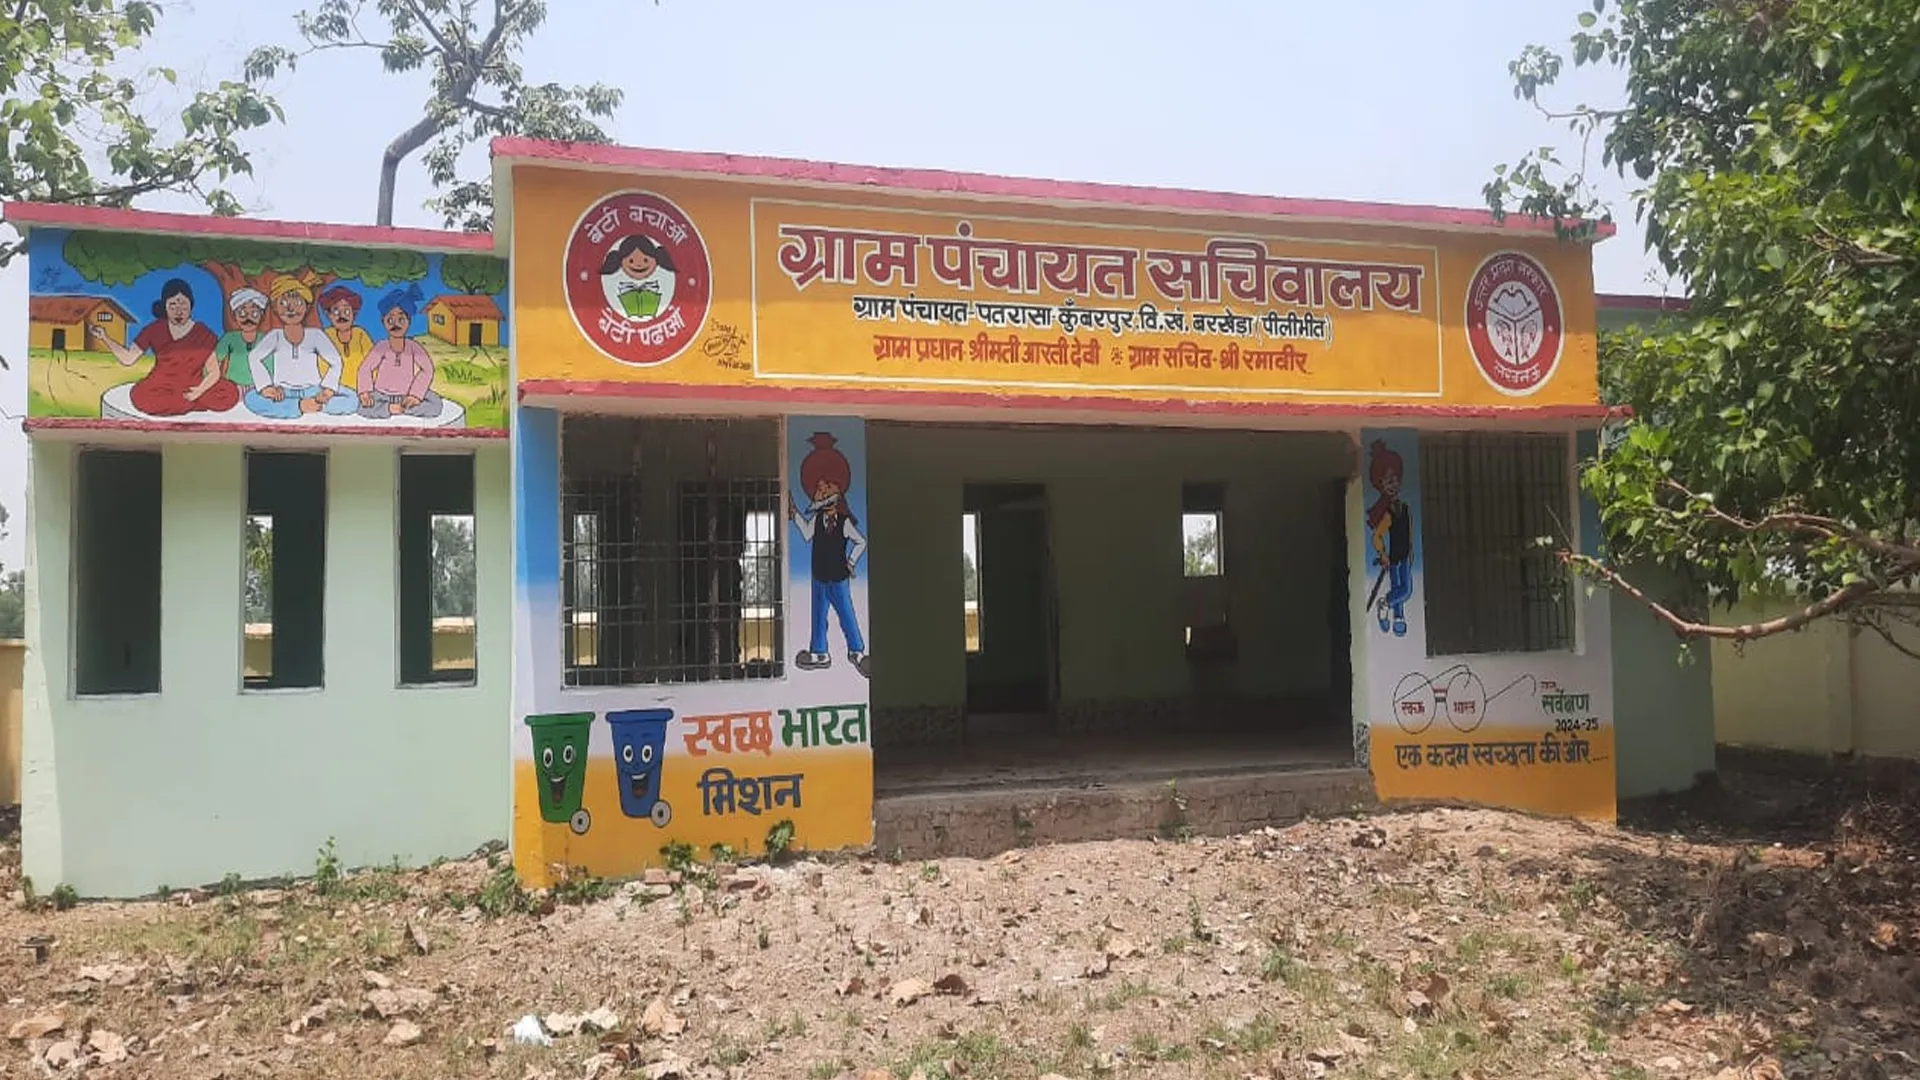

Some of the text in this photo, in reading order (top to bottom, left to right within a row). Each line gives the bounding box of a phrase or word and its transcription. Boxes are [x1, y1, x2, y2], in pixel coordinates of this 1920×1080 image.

[584, 204, 621, 244] बेटी
[779, 219, 1424, 312] ग्राम पंचायत सचिवालय
[599, 307, 635, 344] बेटी
[853, 296, 896, 319] ग्राम
[873, 335, 912, 361] ग्राम
[969, 331, 1021, 363] श्रीमती
[1022, 336, 1068, 366] आरती
[1070, 337, 1101, 368] देवी
[1127, 345, 1160, 370] ग्राम
[1219, 342, 1240, 371] श्री
[682, 703, 867, 757] स्वच्छ भारत
[1555, 717, 1599, 734] 2024-25
[1394, 744, 1422, 769] एक
[1426, 743, 1470, 768] कदम
[1540, 732, 1561, 764] की
[697, 767, 804, 816] मिशन
